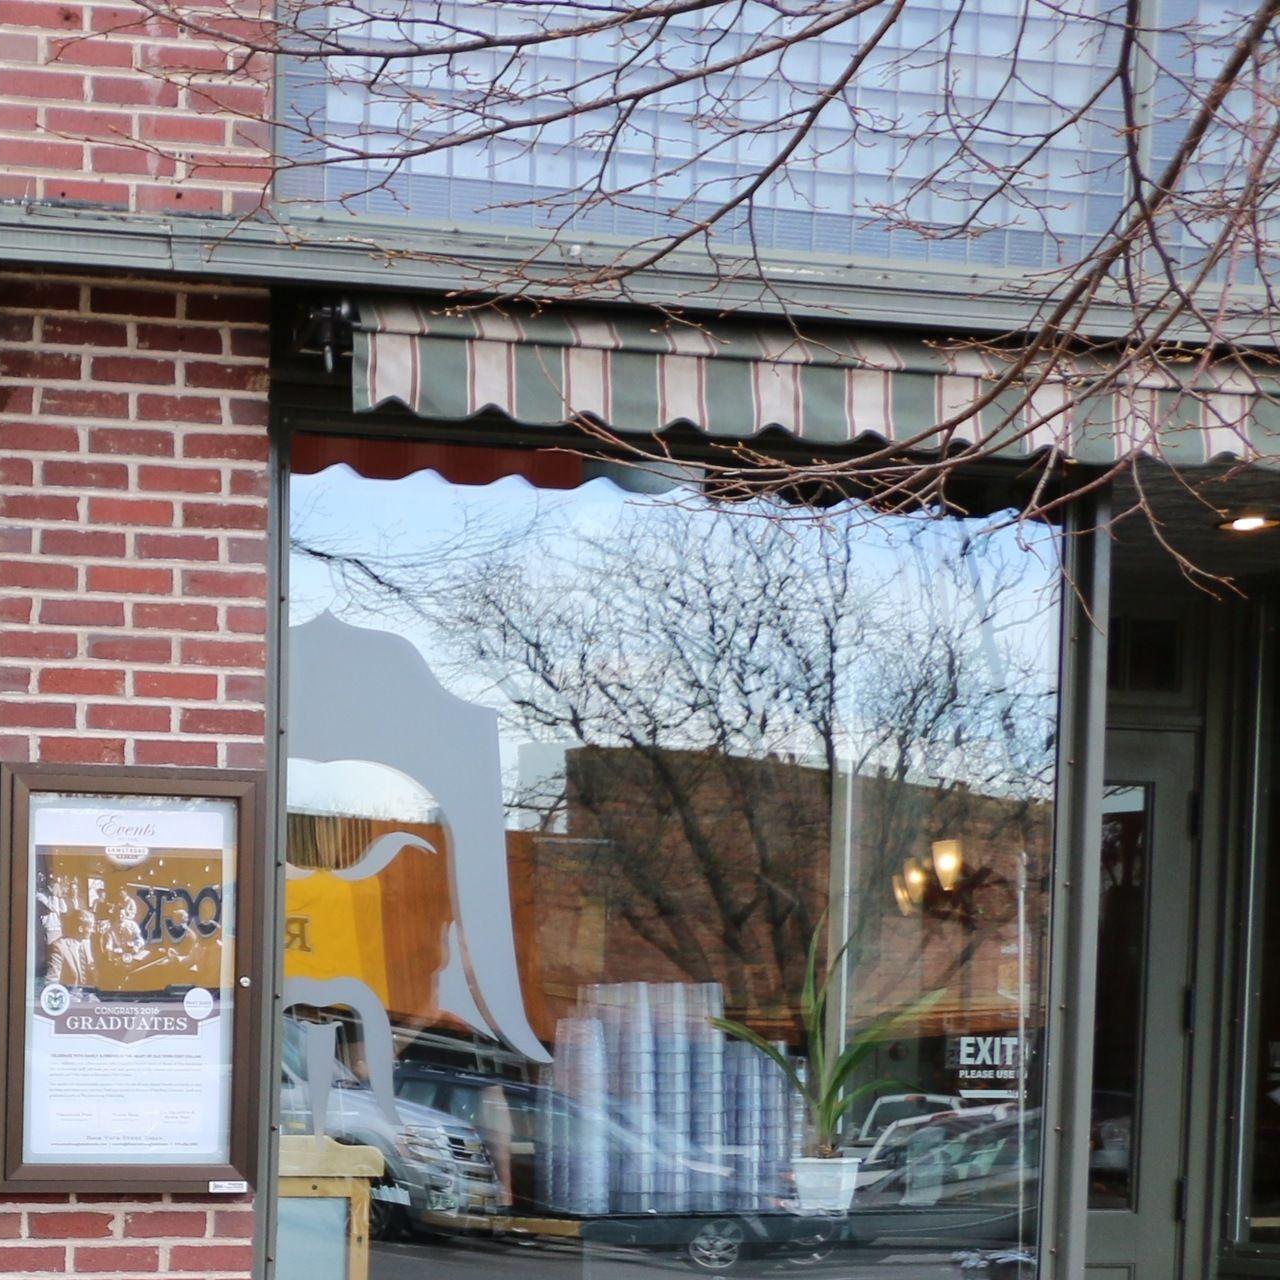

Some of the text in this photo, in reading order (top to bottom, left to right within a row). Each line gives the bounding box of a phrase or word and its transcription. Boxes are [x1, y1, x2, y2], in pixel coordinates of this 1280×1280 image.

[96, 814, 157, 839] Events
[95, 1006, 160, 1015] CONGRATS 2016
[66, 1015, 188, 1031] GRADUATES
[959, 1036, 1018, 1065] EXIT
[959, 1070, 994, 1079] PLEASE
[996, 1070, 1015, 1079] USE
